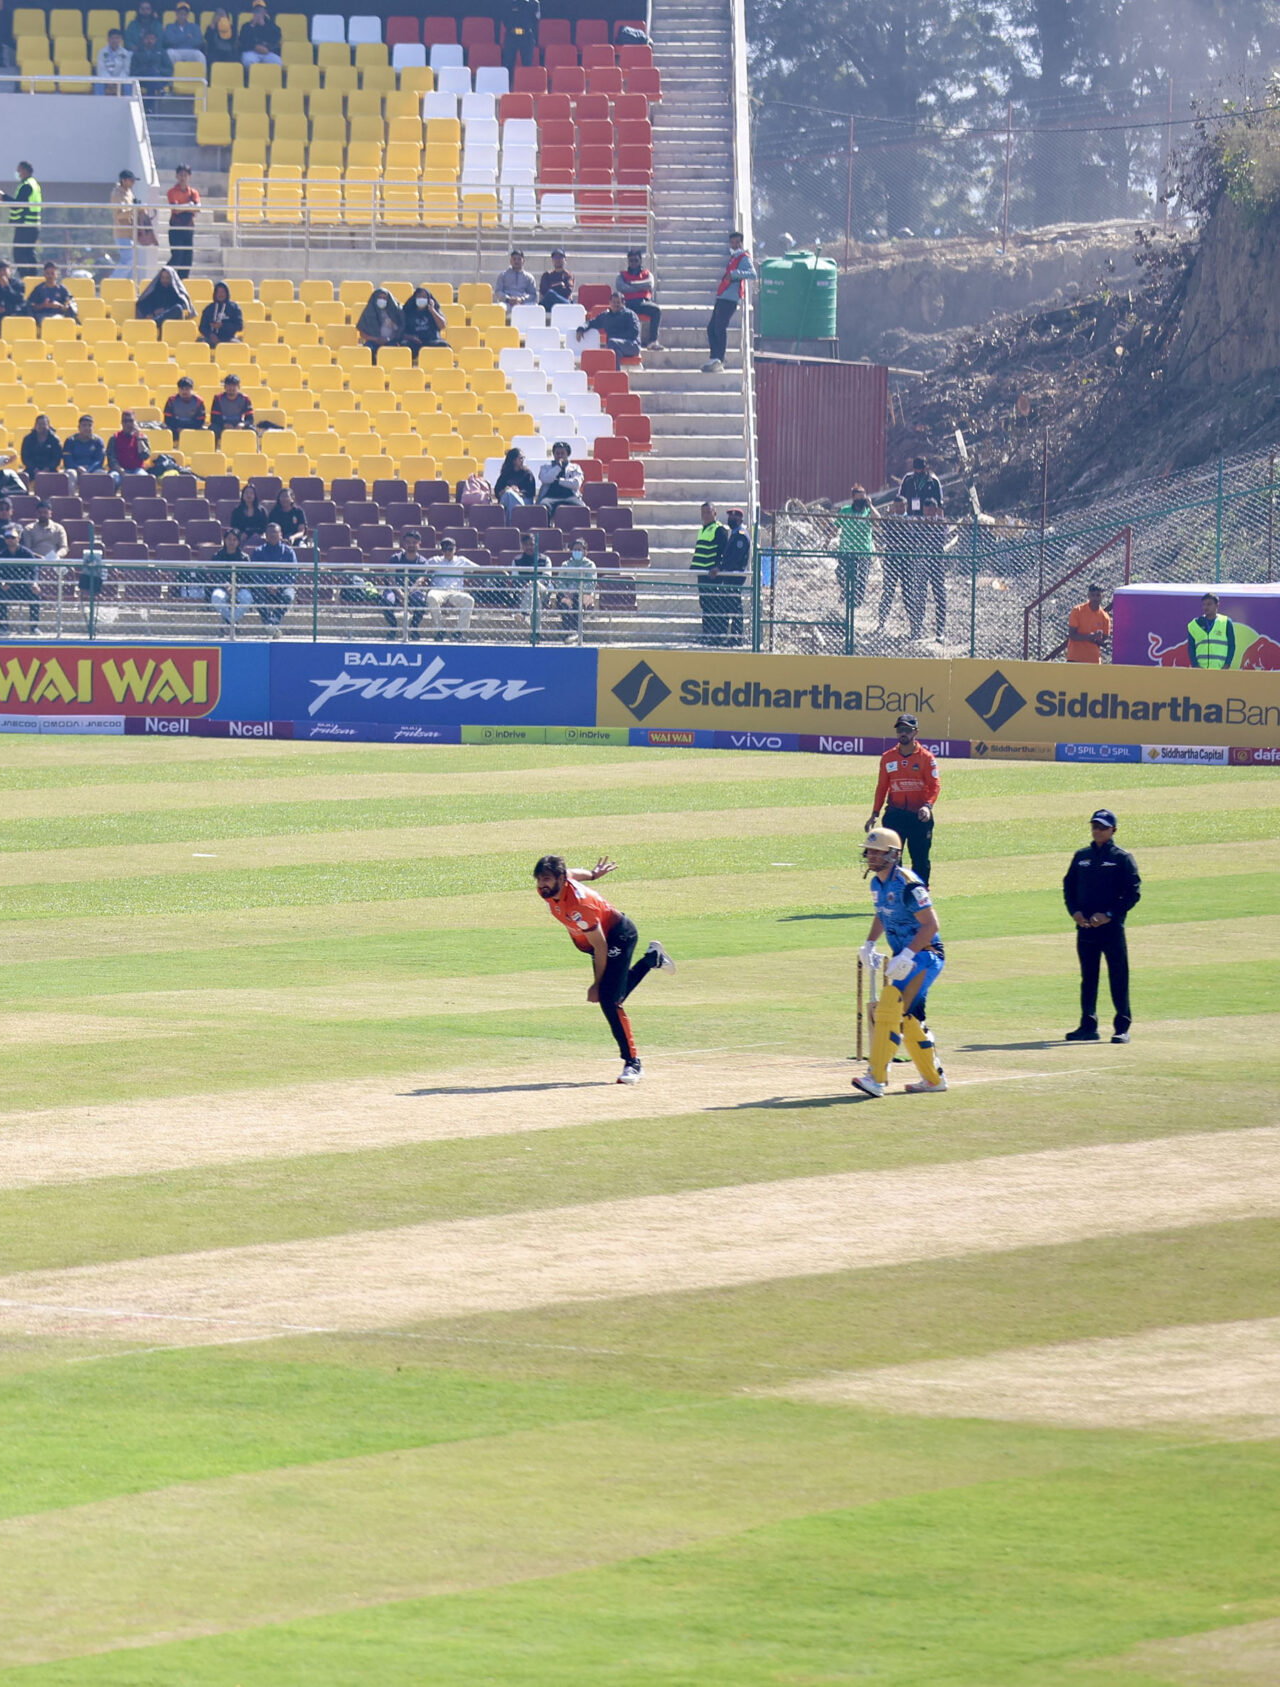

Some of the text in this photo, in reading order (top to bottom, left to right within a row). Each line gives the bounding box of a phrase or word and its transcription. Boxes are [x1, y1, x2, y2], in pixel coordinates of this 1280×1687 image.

[344, 652, 422, 667] BAJAJ
[101, 658, 208, 704] WAI
[145, 717, 189, 733] Ncell
[229, 721, 273, 737] Ncell
[495, 730, 526, 739] inDrive
[579, 730, 611, 740] inDrive
[650, 733, 693, 743] WAI WAI
[730, 733, 782, 748] vivo
[819, 736, 864, 753] Ncell
[1077, 746, 1096, 755] SPIL
[1112, 748, 1131, 757] SPIL
[1161, 747, 1224, 762] Siddhartha Capital
